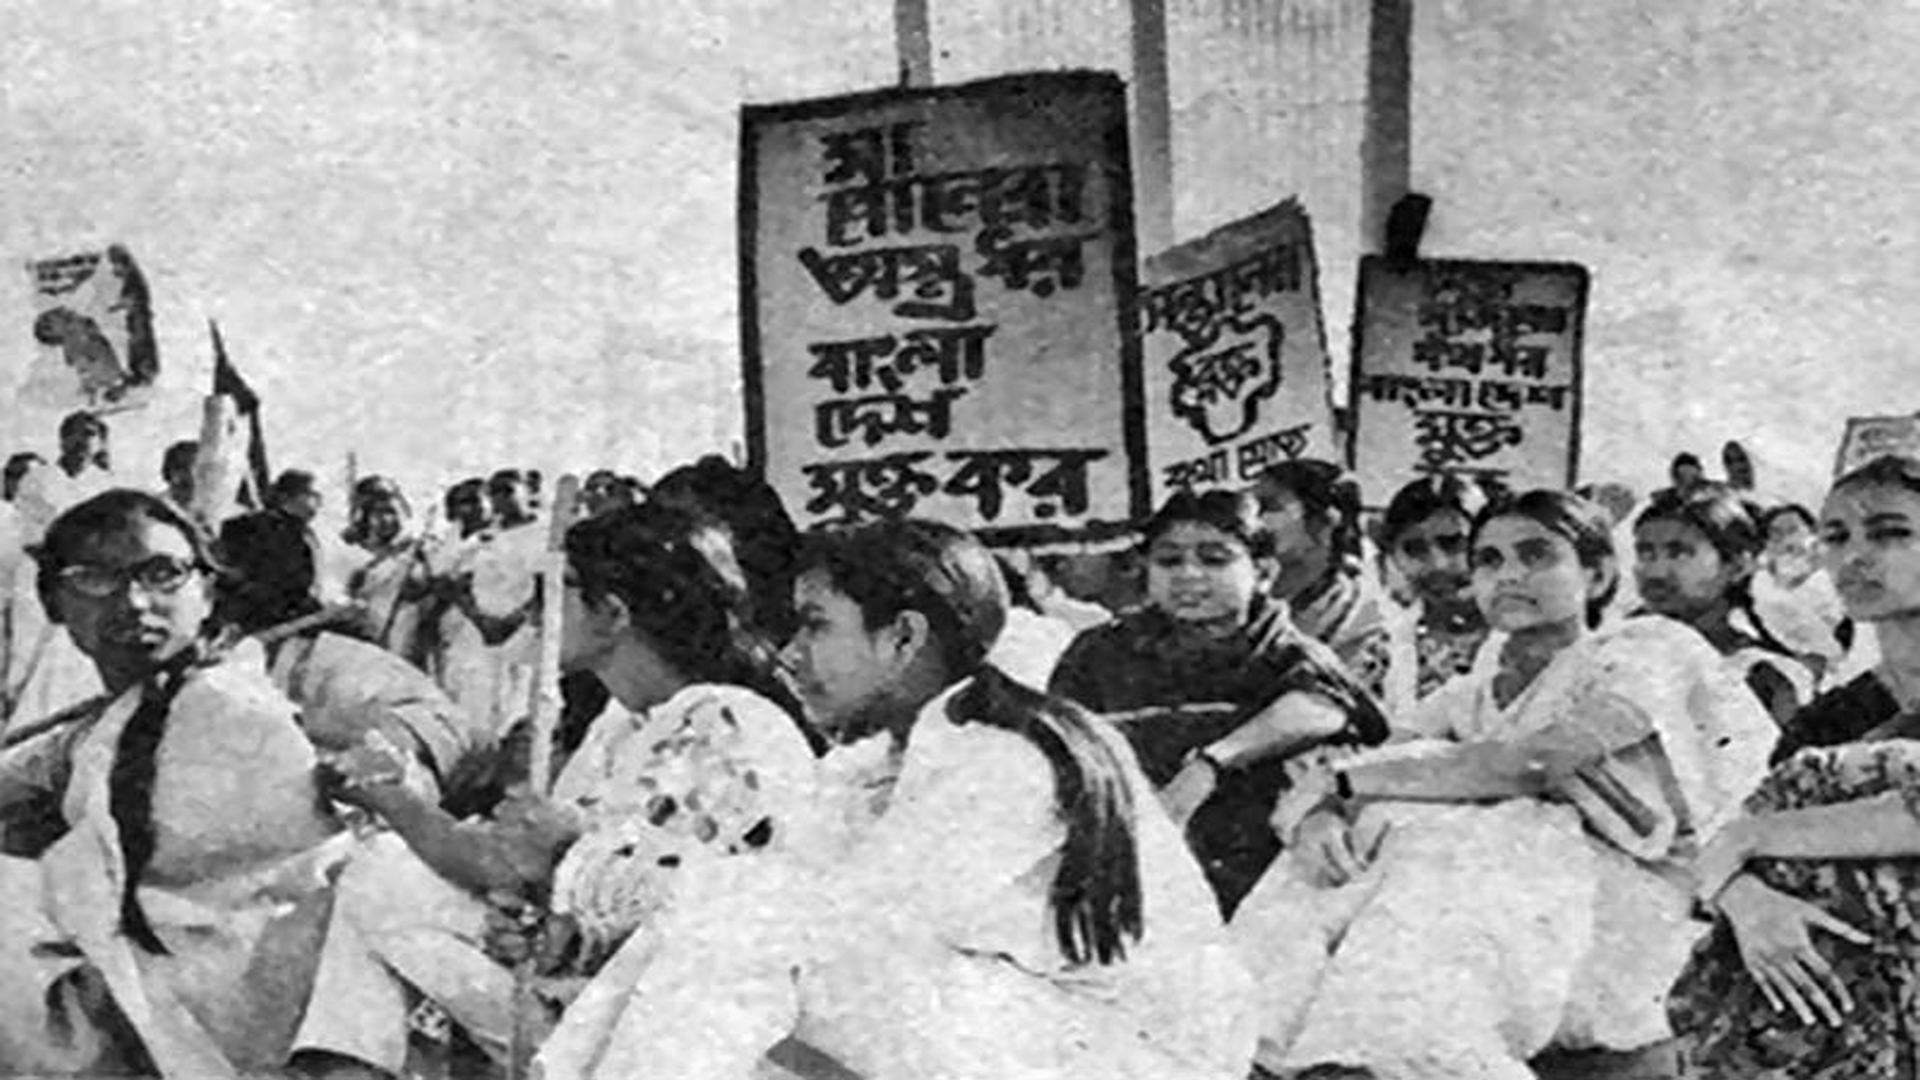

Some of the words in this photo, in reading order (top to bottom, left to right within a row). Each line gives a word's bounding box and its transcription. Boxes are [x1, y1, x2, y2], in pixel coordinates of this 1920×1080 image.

[819, 120, 925, 183] মা
[797, 243, 976, 321] অস্ত্র
[976, 227, 1101, 298] ধর
[807, 324, 998, 393] বাংলা
[815, 386, 968, 447] দেশ
[1413, 409, 1523, 464] মুক্ত
[802, 451, 939, 530] মুক্ত
[942, 448, 1110, 521] কর
